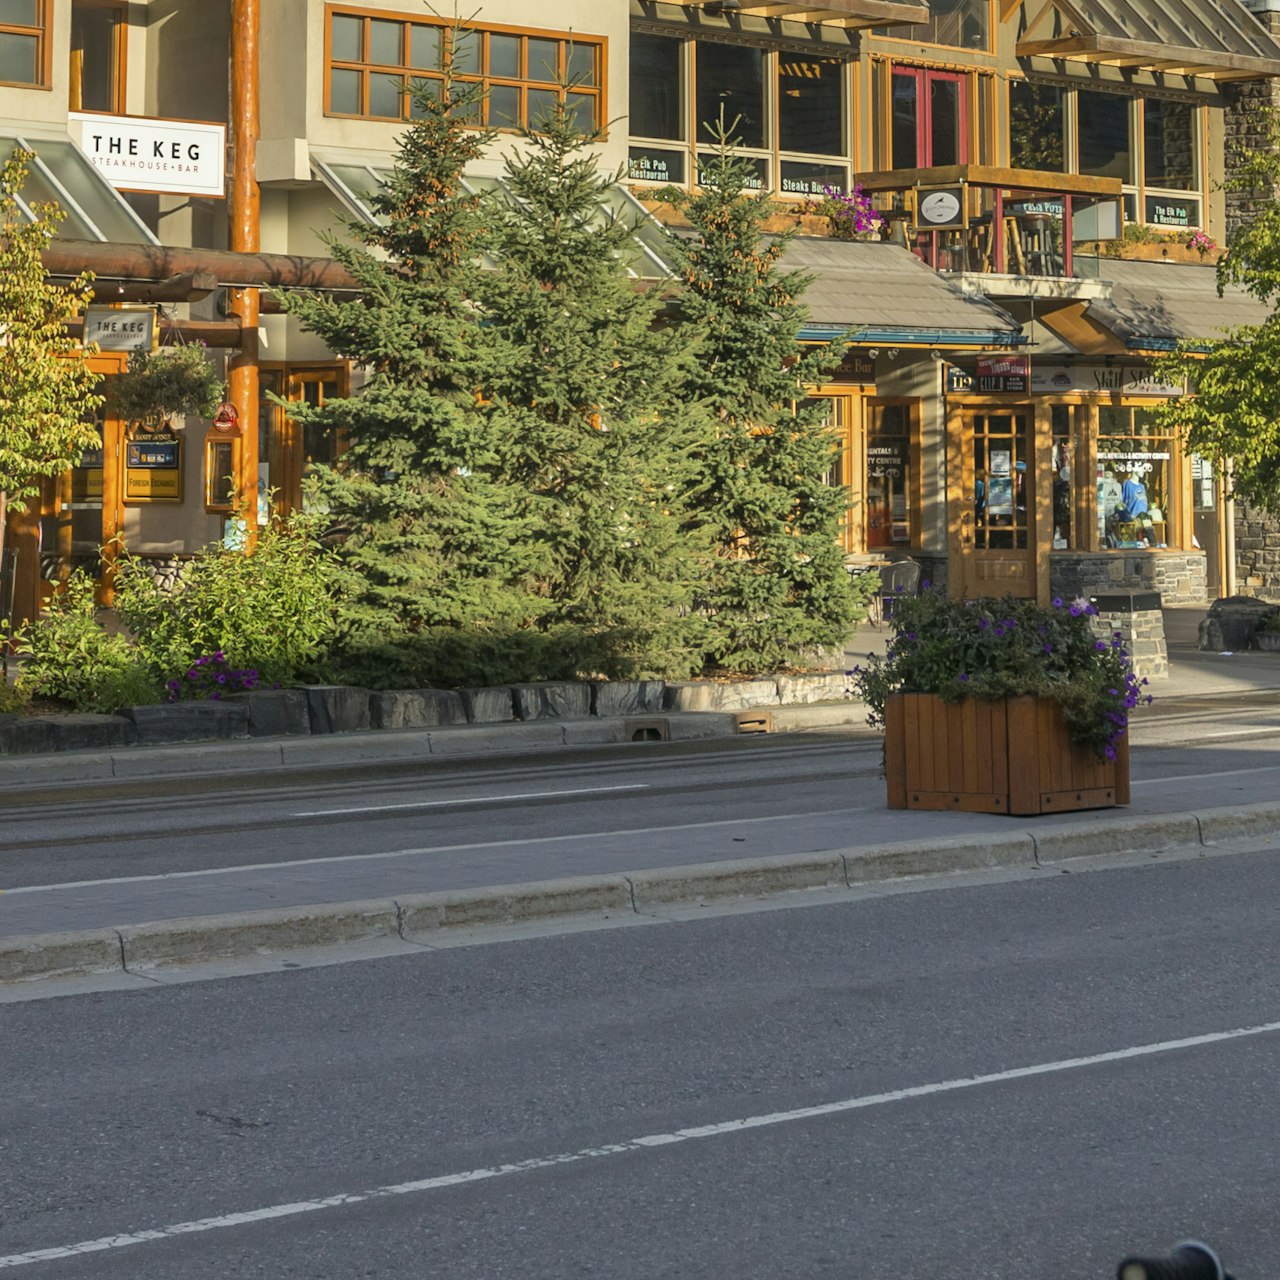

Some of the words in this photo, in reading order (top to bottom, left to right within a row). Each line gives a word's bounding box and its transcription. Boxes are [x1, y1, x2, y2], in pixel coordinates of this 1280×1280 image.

[92, 135, 138, 156] THE
[153, 140, 200, 161] KEG
[653, 159, 667, 171] Pub
[630, 167, 669, 181] Restaurant
[782, 178, 809, 192] Steaks
[811, 181, 841, 195] Buers
[1044, 202, 1064, 215] Pizza
[1155, 205, 1166, 216] The
[1167, 206, 1175, 217] Elk
[1175, 207, 1187, 218] Pub
[1159, 216, 1189, 226] Restaurant
[96, 321, 118, 332] THE
[122, 322, 145, 333] KEG
[854, 358, 873, 374] Bar
[952, 376, 973, 389] 119
[875, 457, 902, 465] CENTRE
